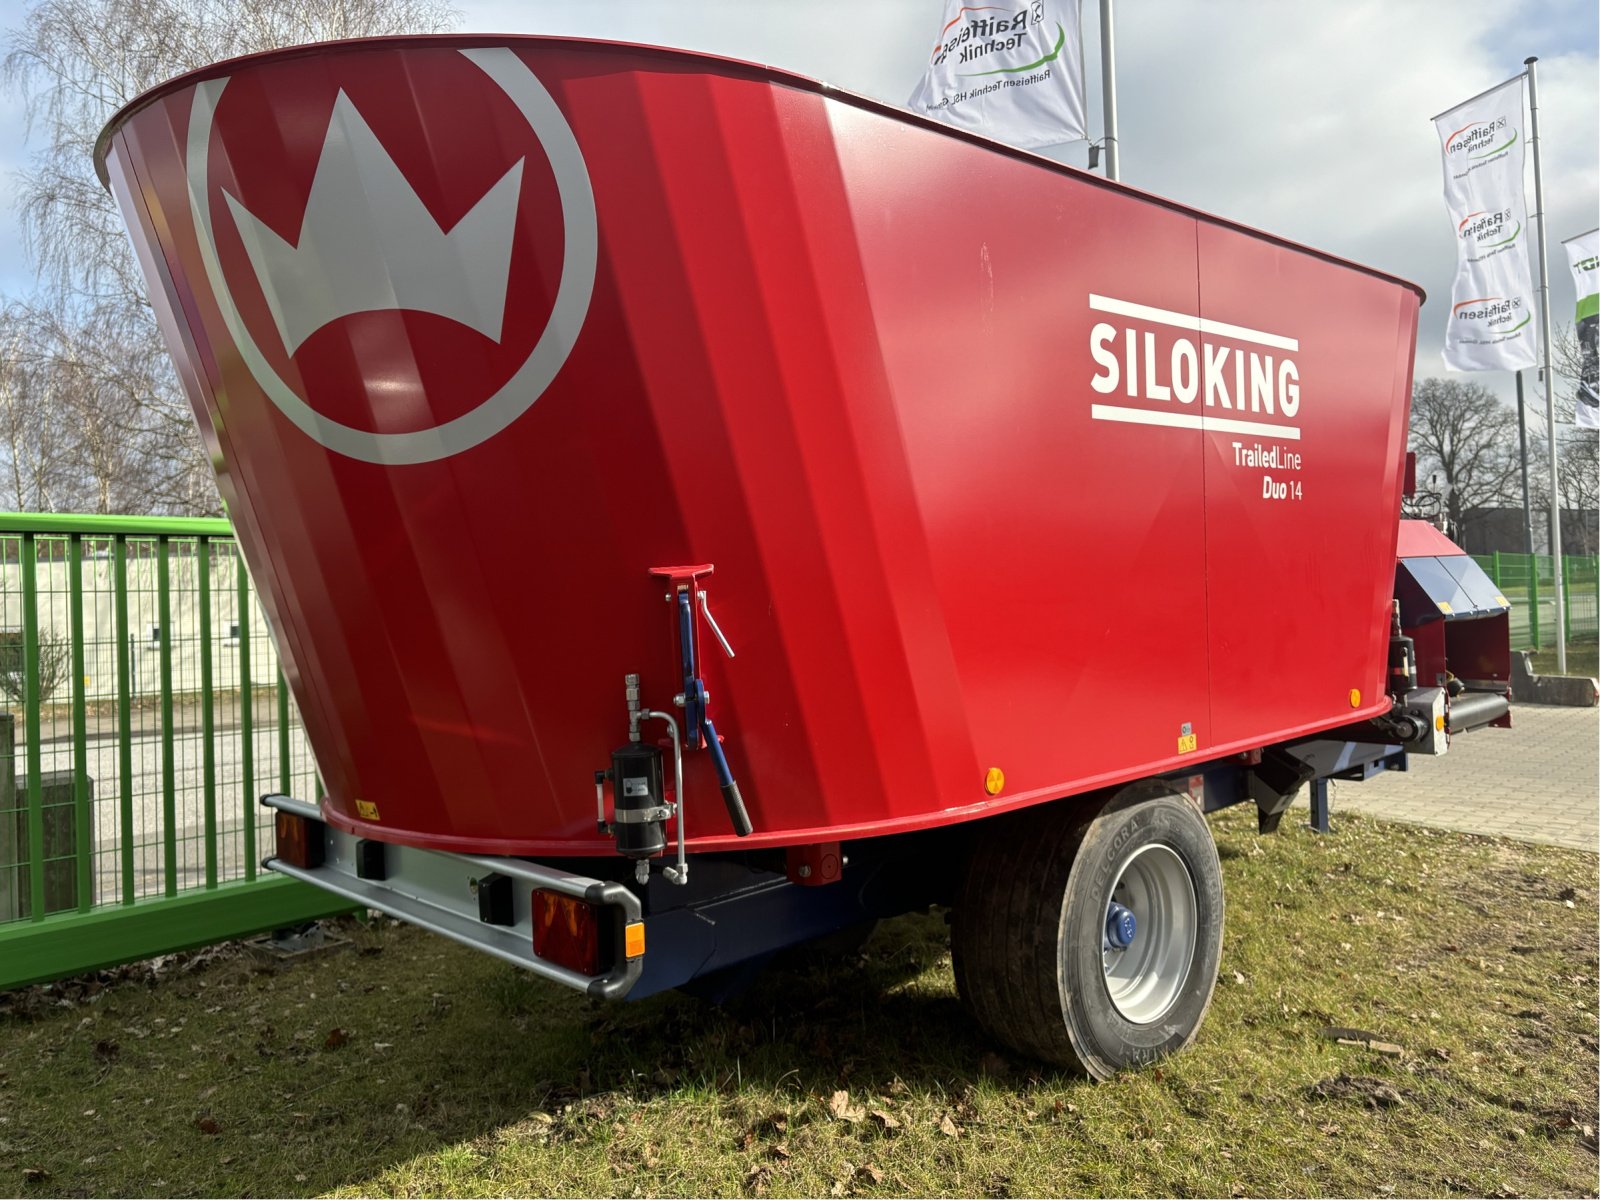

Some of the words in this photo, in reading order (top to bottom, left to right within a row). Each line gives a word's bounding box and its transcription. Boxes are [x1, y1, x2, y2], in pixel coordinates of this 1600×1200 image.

[1089, 322, 1300, 418] SILOKING
[1232, 441, 1302, 471] TrailedLine
[1262, 475, 1287, 500] Duo
[1289, 480, 1302, 500] 14
